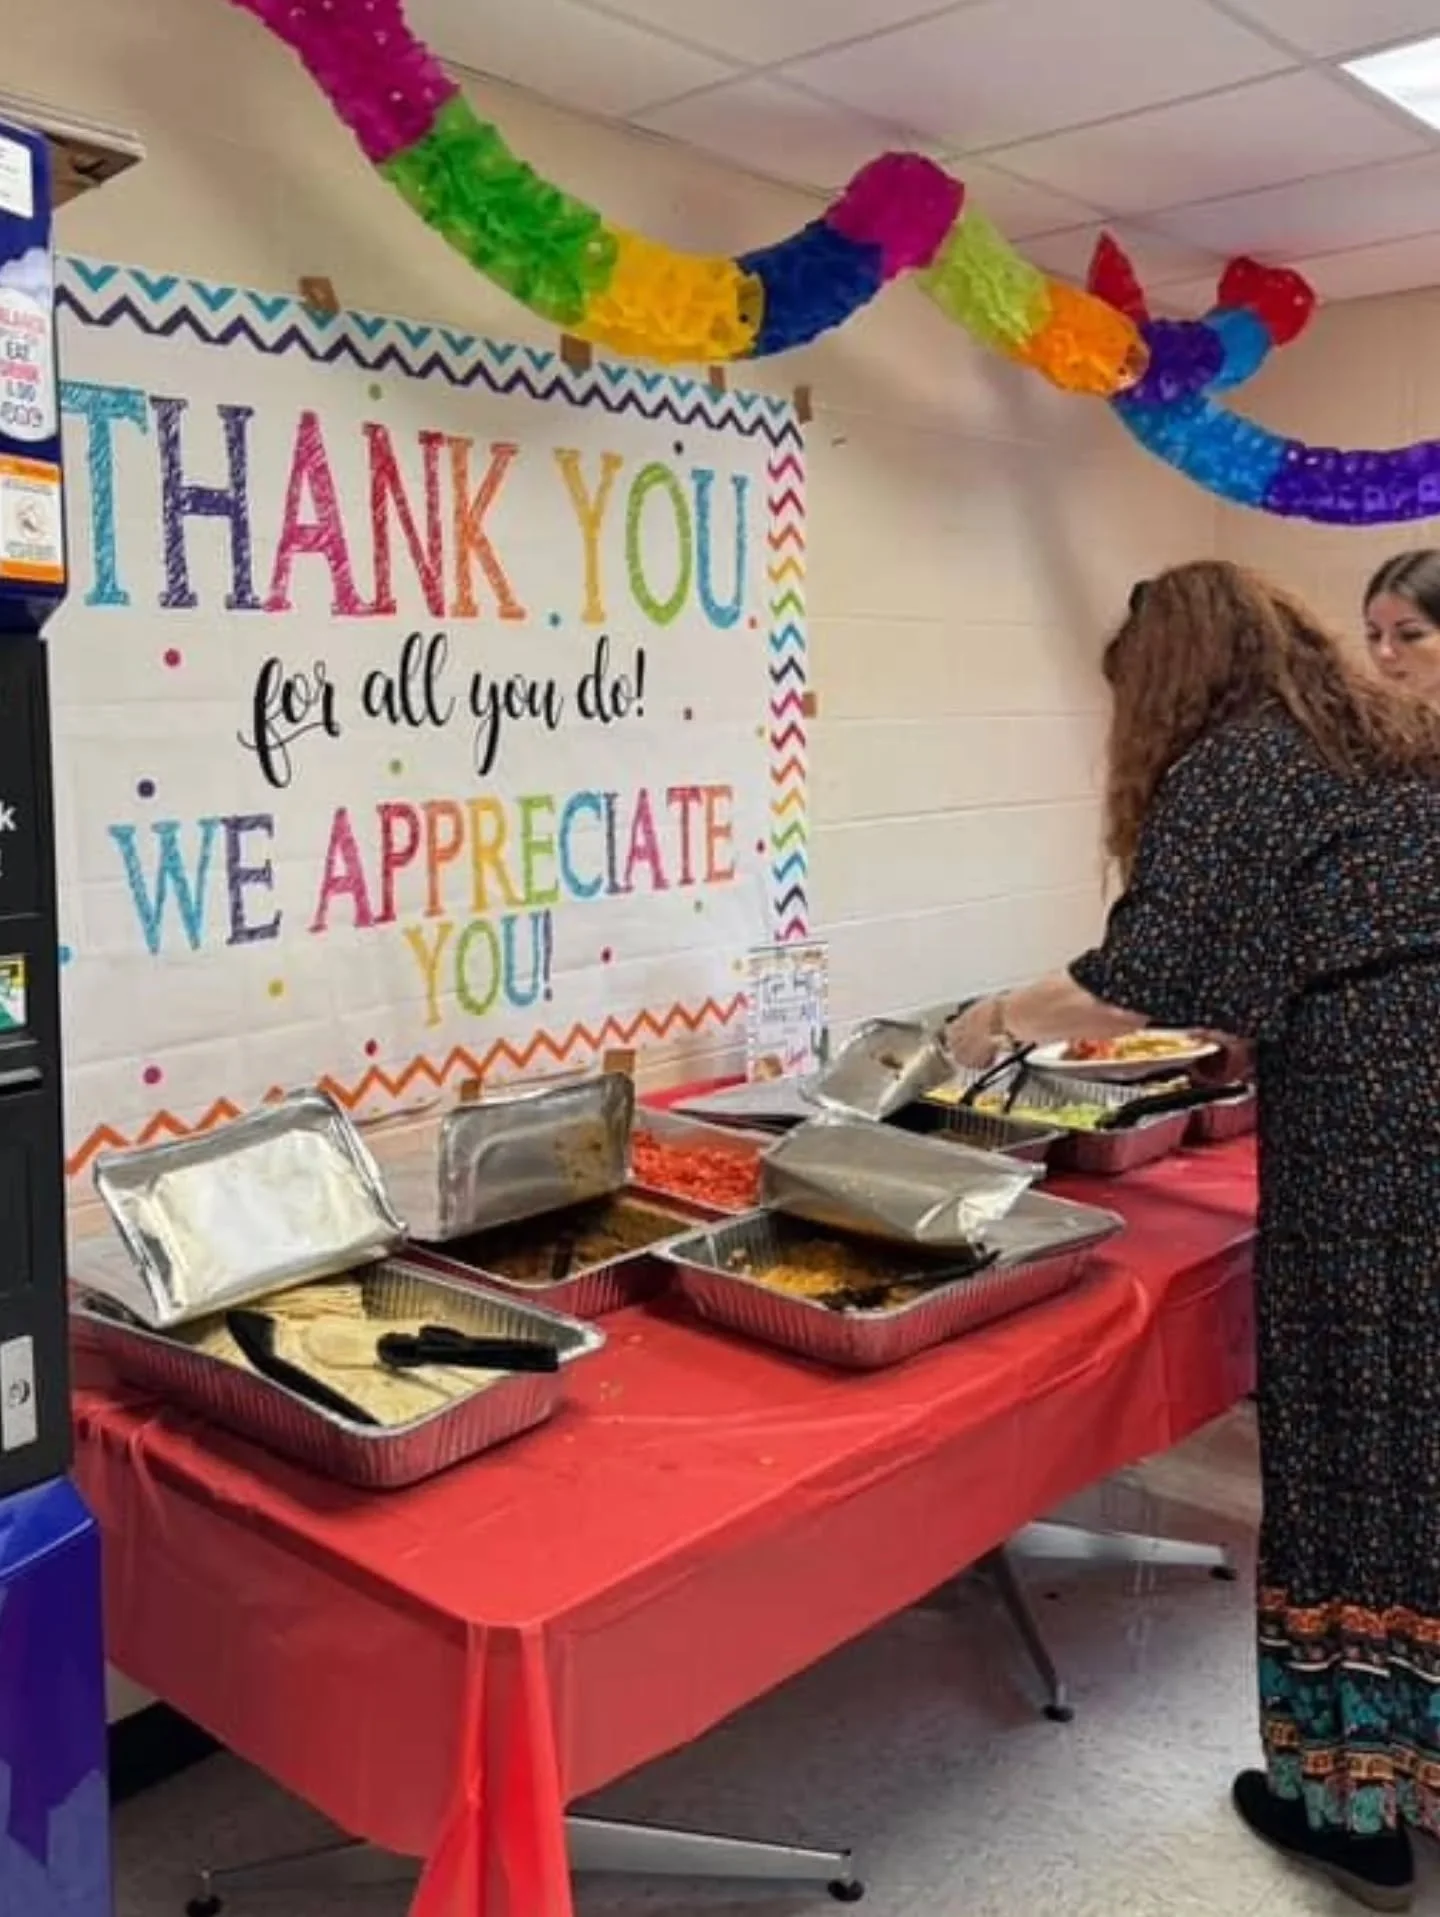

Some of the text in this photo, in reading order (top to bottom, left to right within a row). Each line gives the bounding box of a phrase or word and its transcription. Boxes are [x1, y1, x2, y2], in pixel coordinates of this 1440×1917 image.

[60, 380, 748, 629] THANK YOU
[237, 632, 646, 788] for all you do!
[107, 784, 738, 955] WE APPRECIATE
[402, 908, 553, 1028] YOU!
